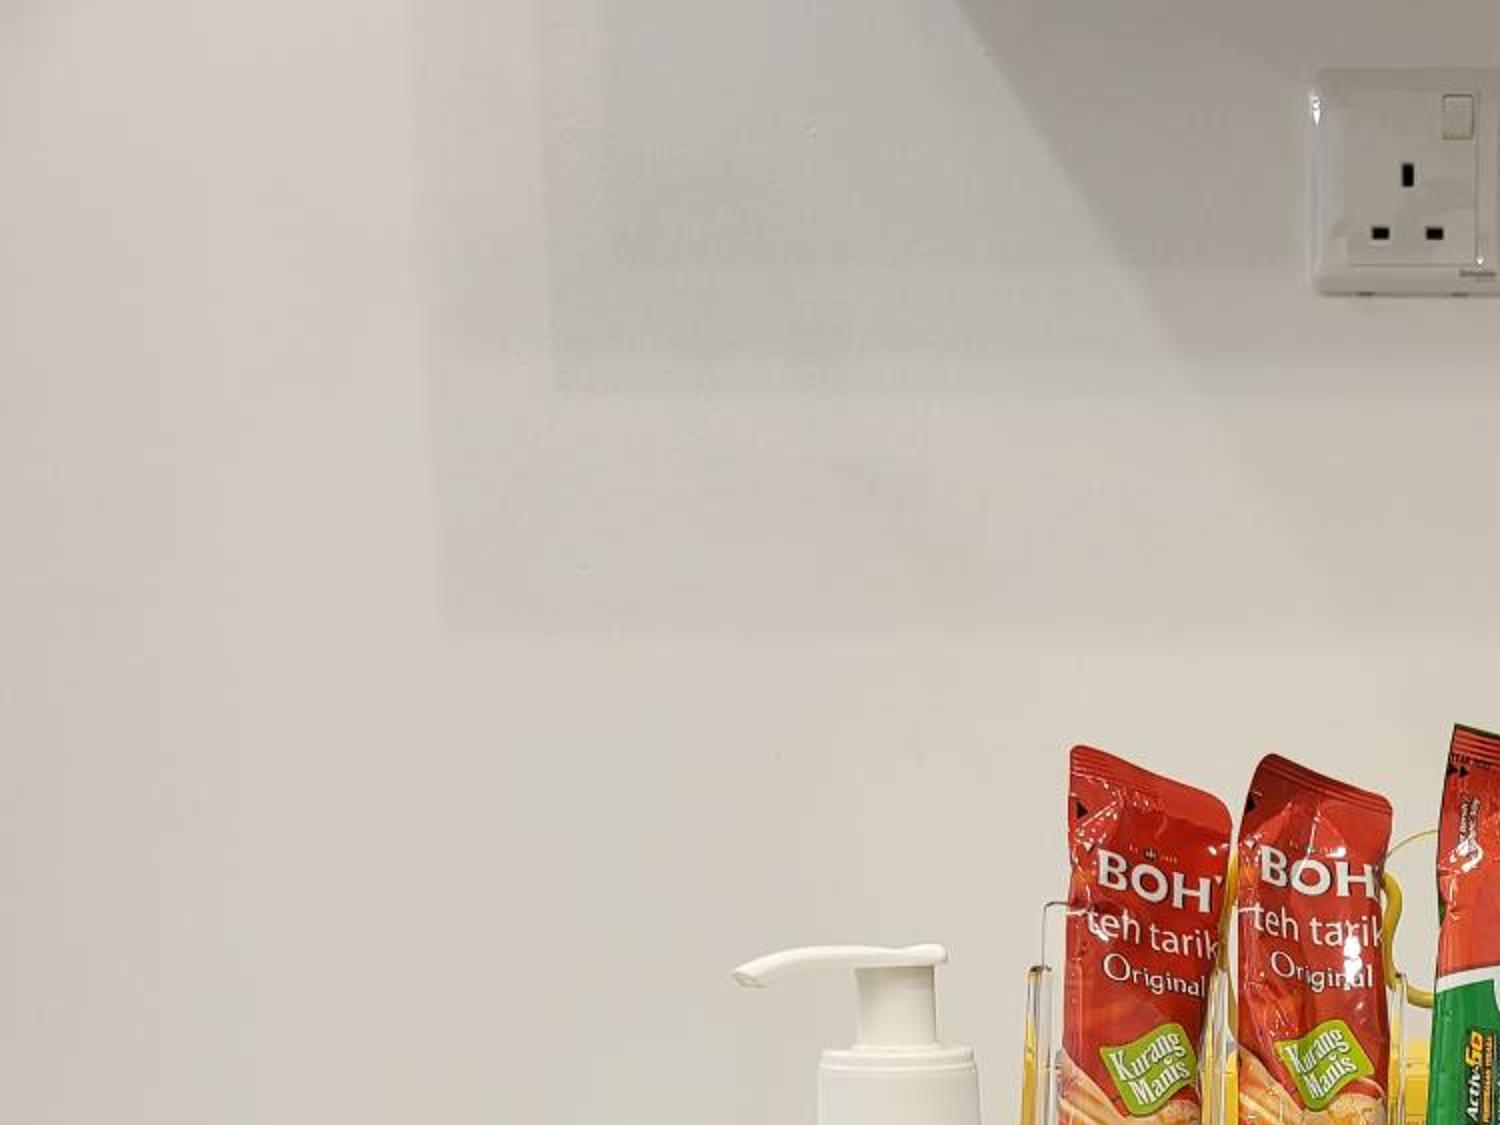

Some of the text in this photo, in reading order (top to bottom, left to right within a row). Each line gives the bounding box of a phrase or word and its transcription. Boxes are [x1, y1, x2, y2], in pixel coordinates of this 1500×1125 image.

[1097, 848, 1211, 913] BOH
[1259, 844, 1376, 898] BOH
[1087, 907, 1219, 960] teh tarik
[1252, 902, 1383, 948] teh tarik
[1103, 952, 1206, 998] Original
[1109, 1033, 1187, 1081] Kurang
[1284, 1029, 1351, 1073] Kurang
[1128, 1056, 1191, 1105] Manis
[1303, 1054, 1358, 1100] Manis
